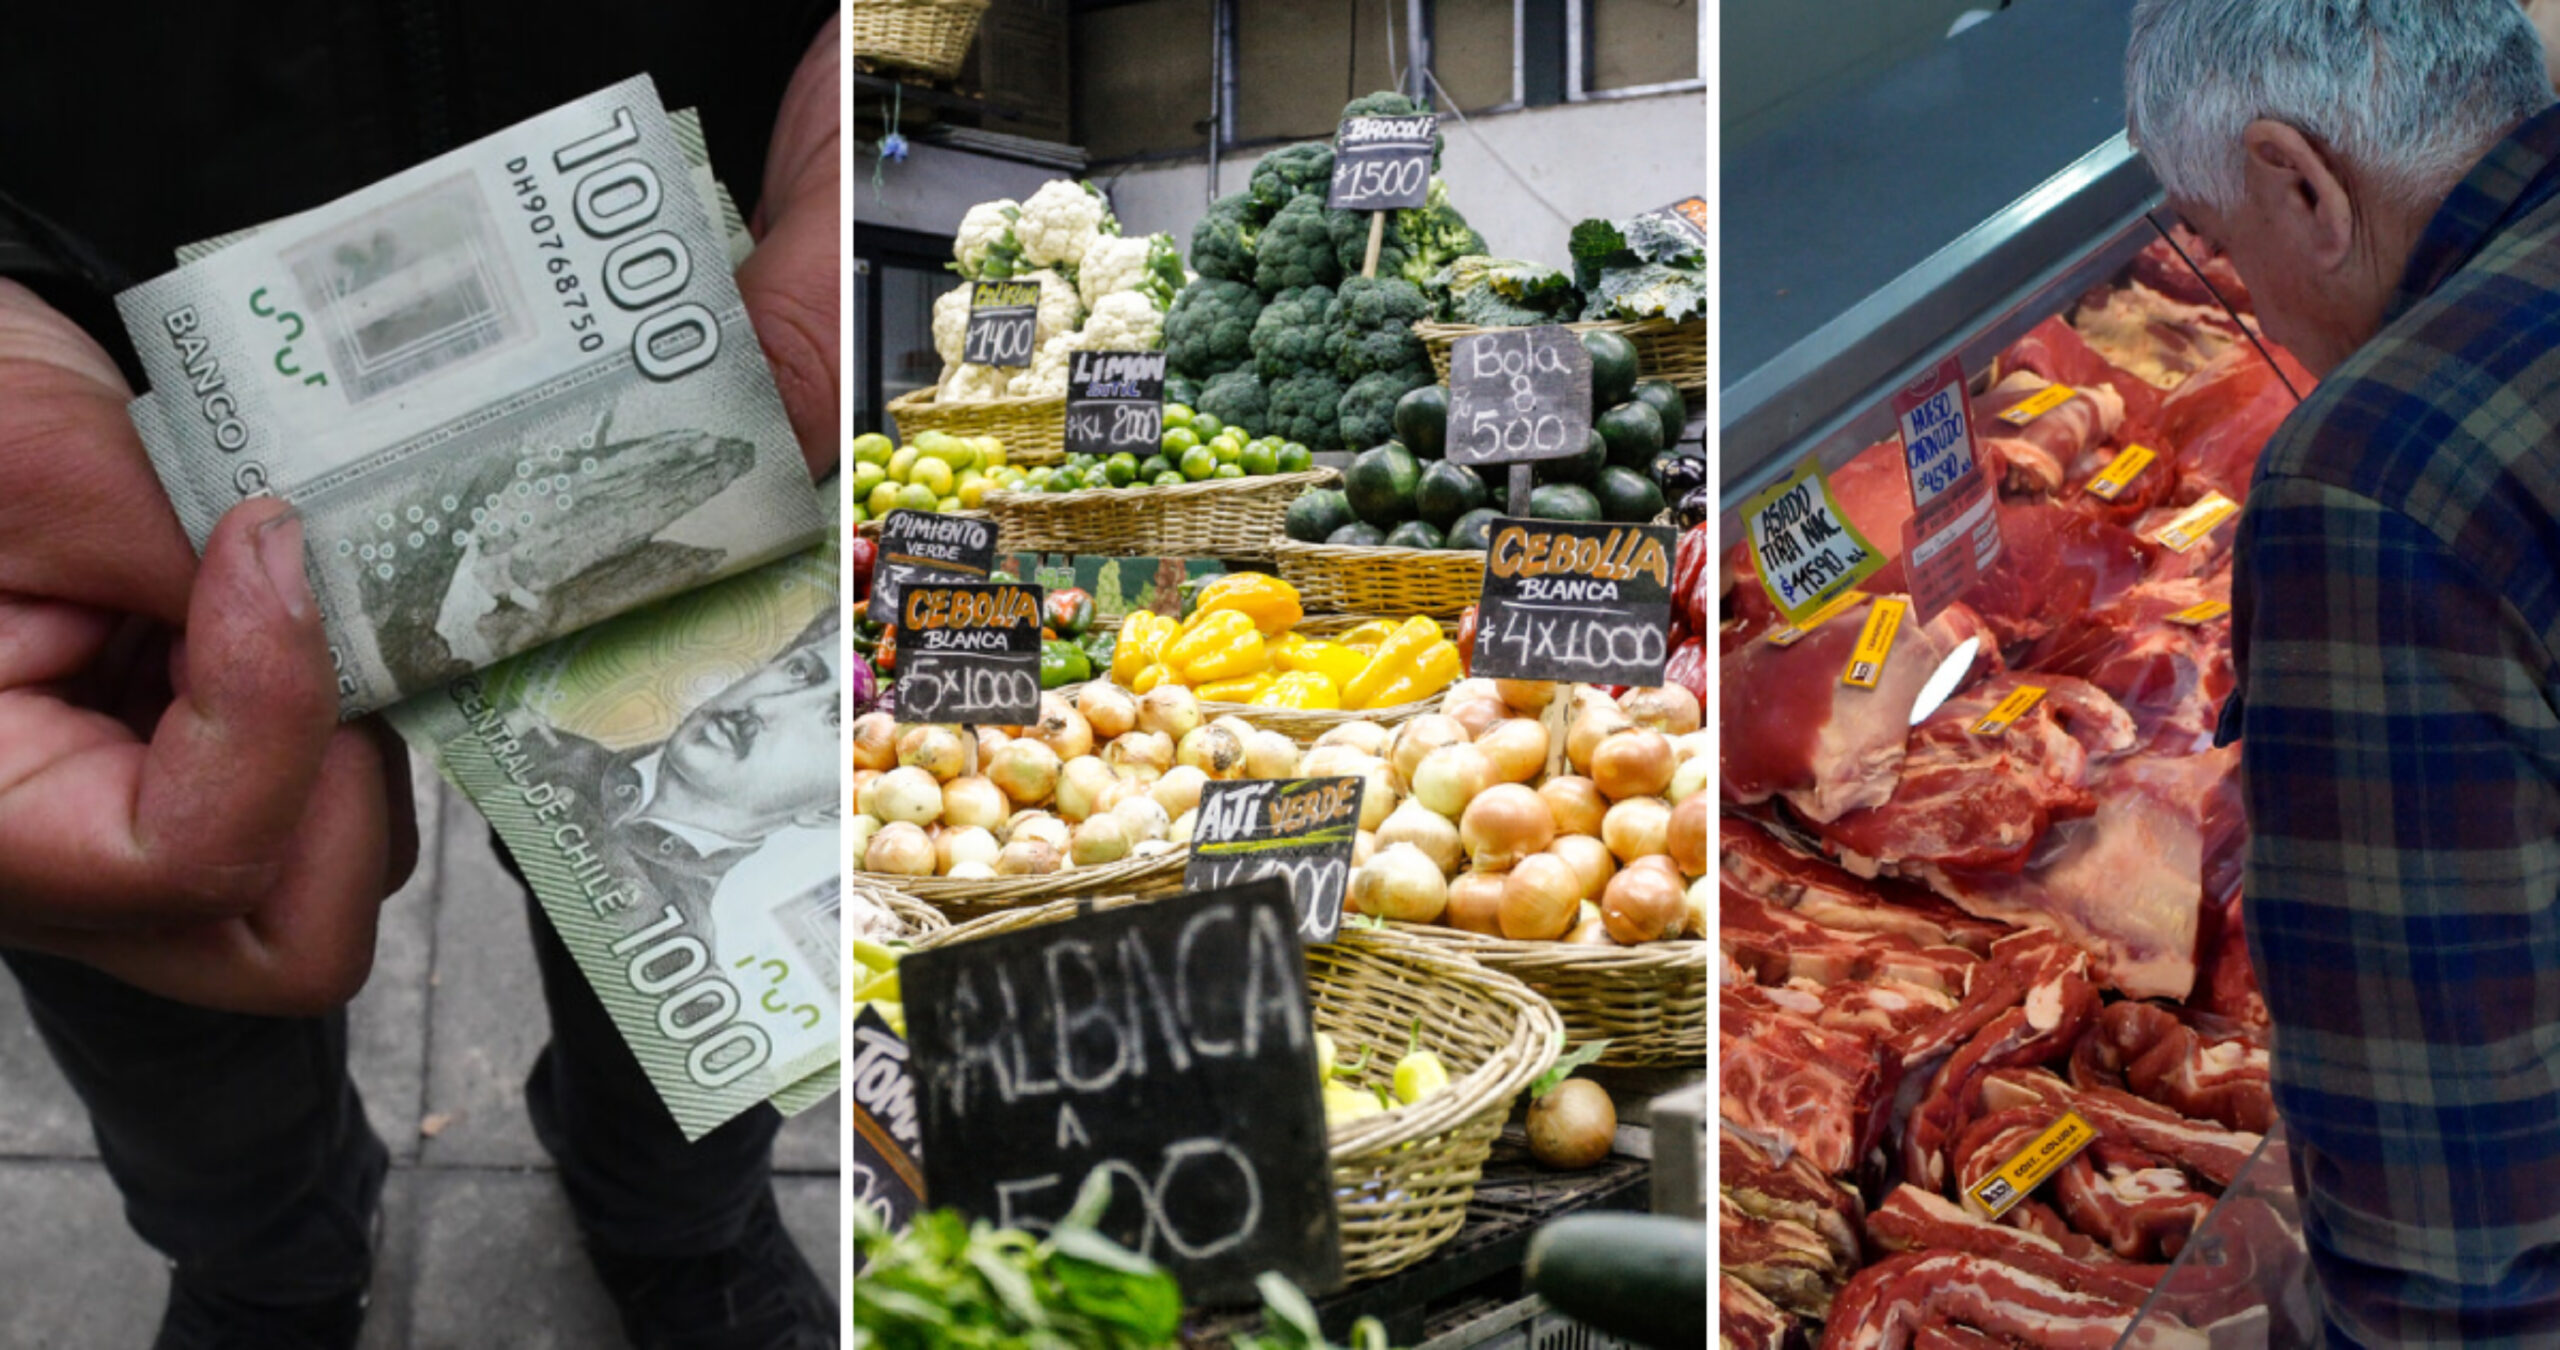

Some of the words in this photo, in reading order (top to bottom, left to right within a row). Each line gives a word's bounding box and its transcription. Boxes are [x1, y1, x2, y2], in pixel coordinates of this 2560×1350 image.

[1332, 157, 1424, 200] $1500
[506, 156, 604, 353] DH90768750
[553, 106, 721, 383] 1000
[965, 319, 1034, 362] $1400
[1473, 332, 1572, 378] Bola
[164, 305, 248, 453] BANCO
[1110, 404, 1161, 445] 2000
[1470, 409, 1567, 459] 500
[1761, 483, 1811, 542] ASADO
[906, 541, 962, 561] VERDE
[1490, 526, 1669, 588] CEBOLLA
[1760, 530, 1805, 572] TIRA
[905, 586, 1040, 631] CEBOLLA
[1516, 578, 1619, 600] BLANCA
[922, 631, 1009, 651] BLANCA
[451, 674, 535, 789] CENTRAL
[522, 782, 568, 826] DE
[553, 823, 630, 920] CHILE
[1268, 777, 1360, 836] VERDE
[608, 903, 773, 1091] 1000
[950, 904, 1310, 1118] ALBACA
